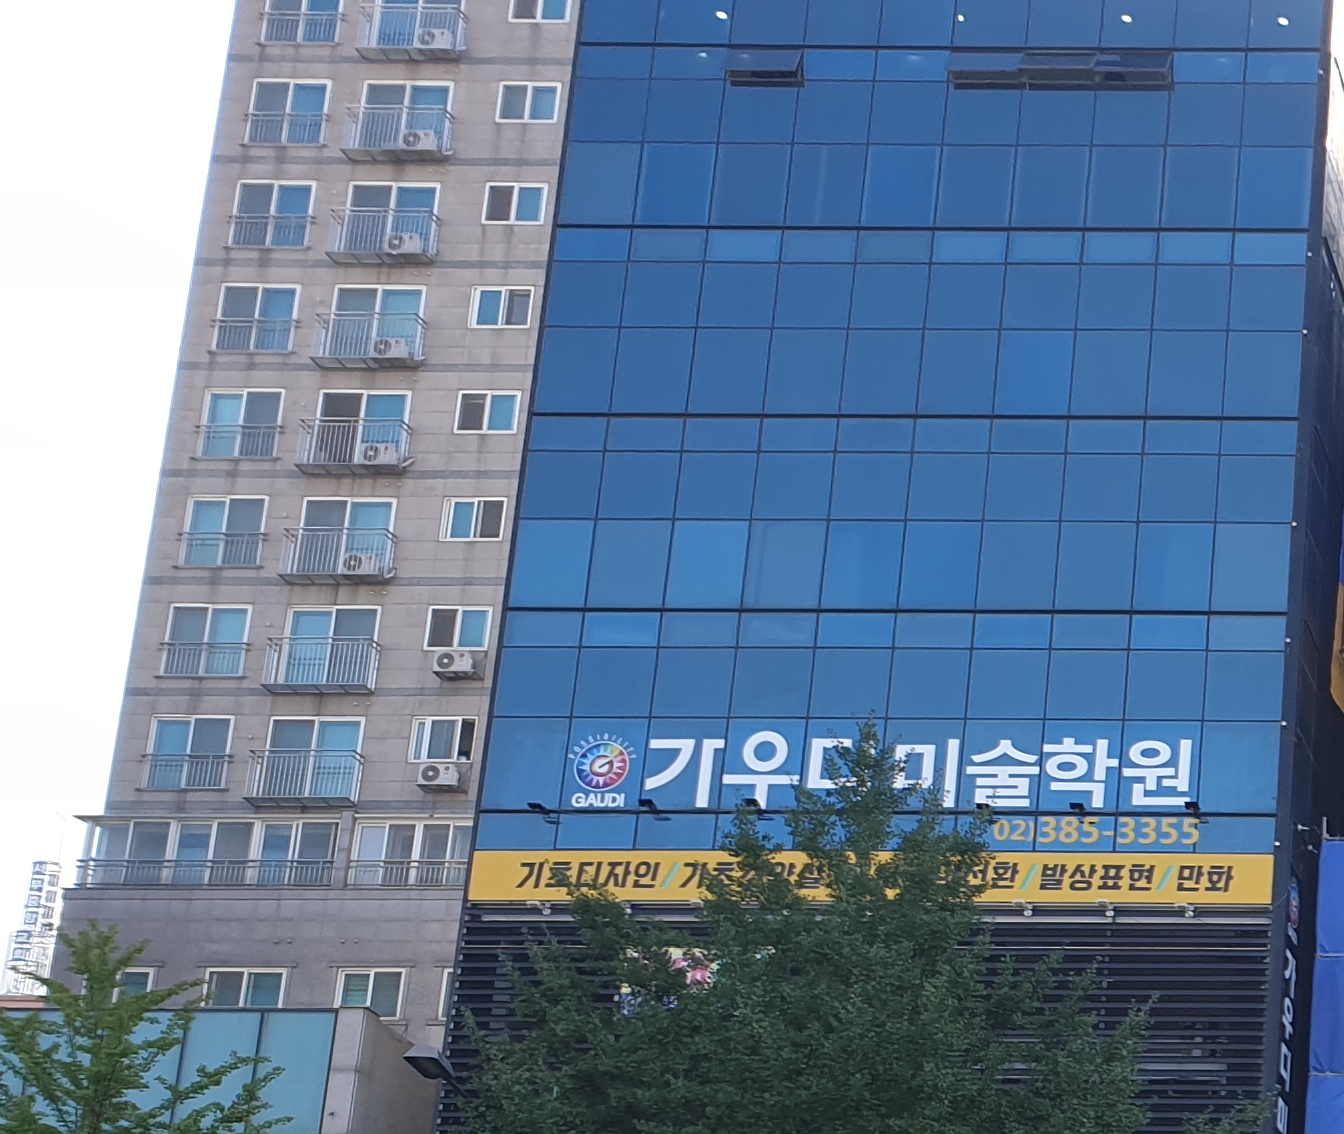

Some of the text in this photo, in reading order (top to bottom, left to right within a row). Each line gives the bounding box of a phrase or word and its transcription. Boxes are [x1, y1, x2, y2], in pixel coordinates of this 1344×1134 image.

[571, 792, 625, 808] GAUDI
[1039, 863, 1157, 893] 발상표현
[1176, 865, 1235, 894] 만화
